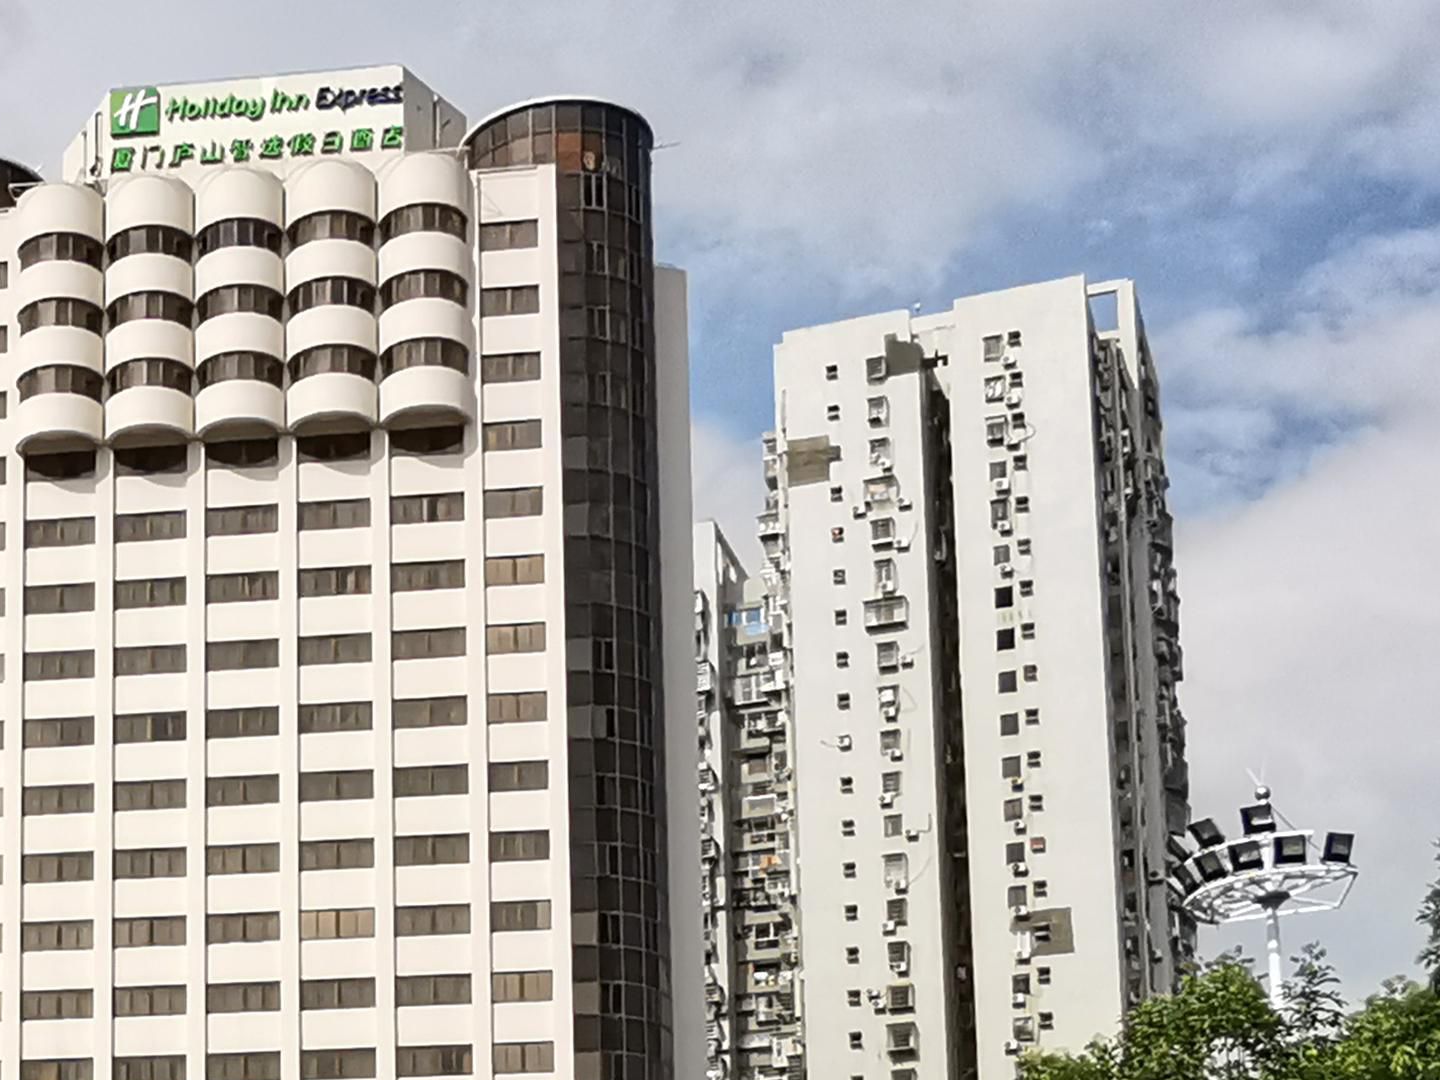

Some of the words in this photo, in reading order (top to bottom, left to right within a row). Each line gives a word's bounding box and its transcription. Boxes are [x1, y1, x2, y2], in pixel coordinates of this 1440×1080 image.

[165, 92, 265, 122] Holiday
[270, 88, 310, 114] Inn
[315, 84, 404, 112] Express
